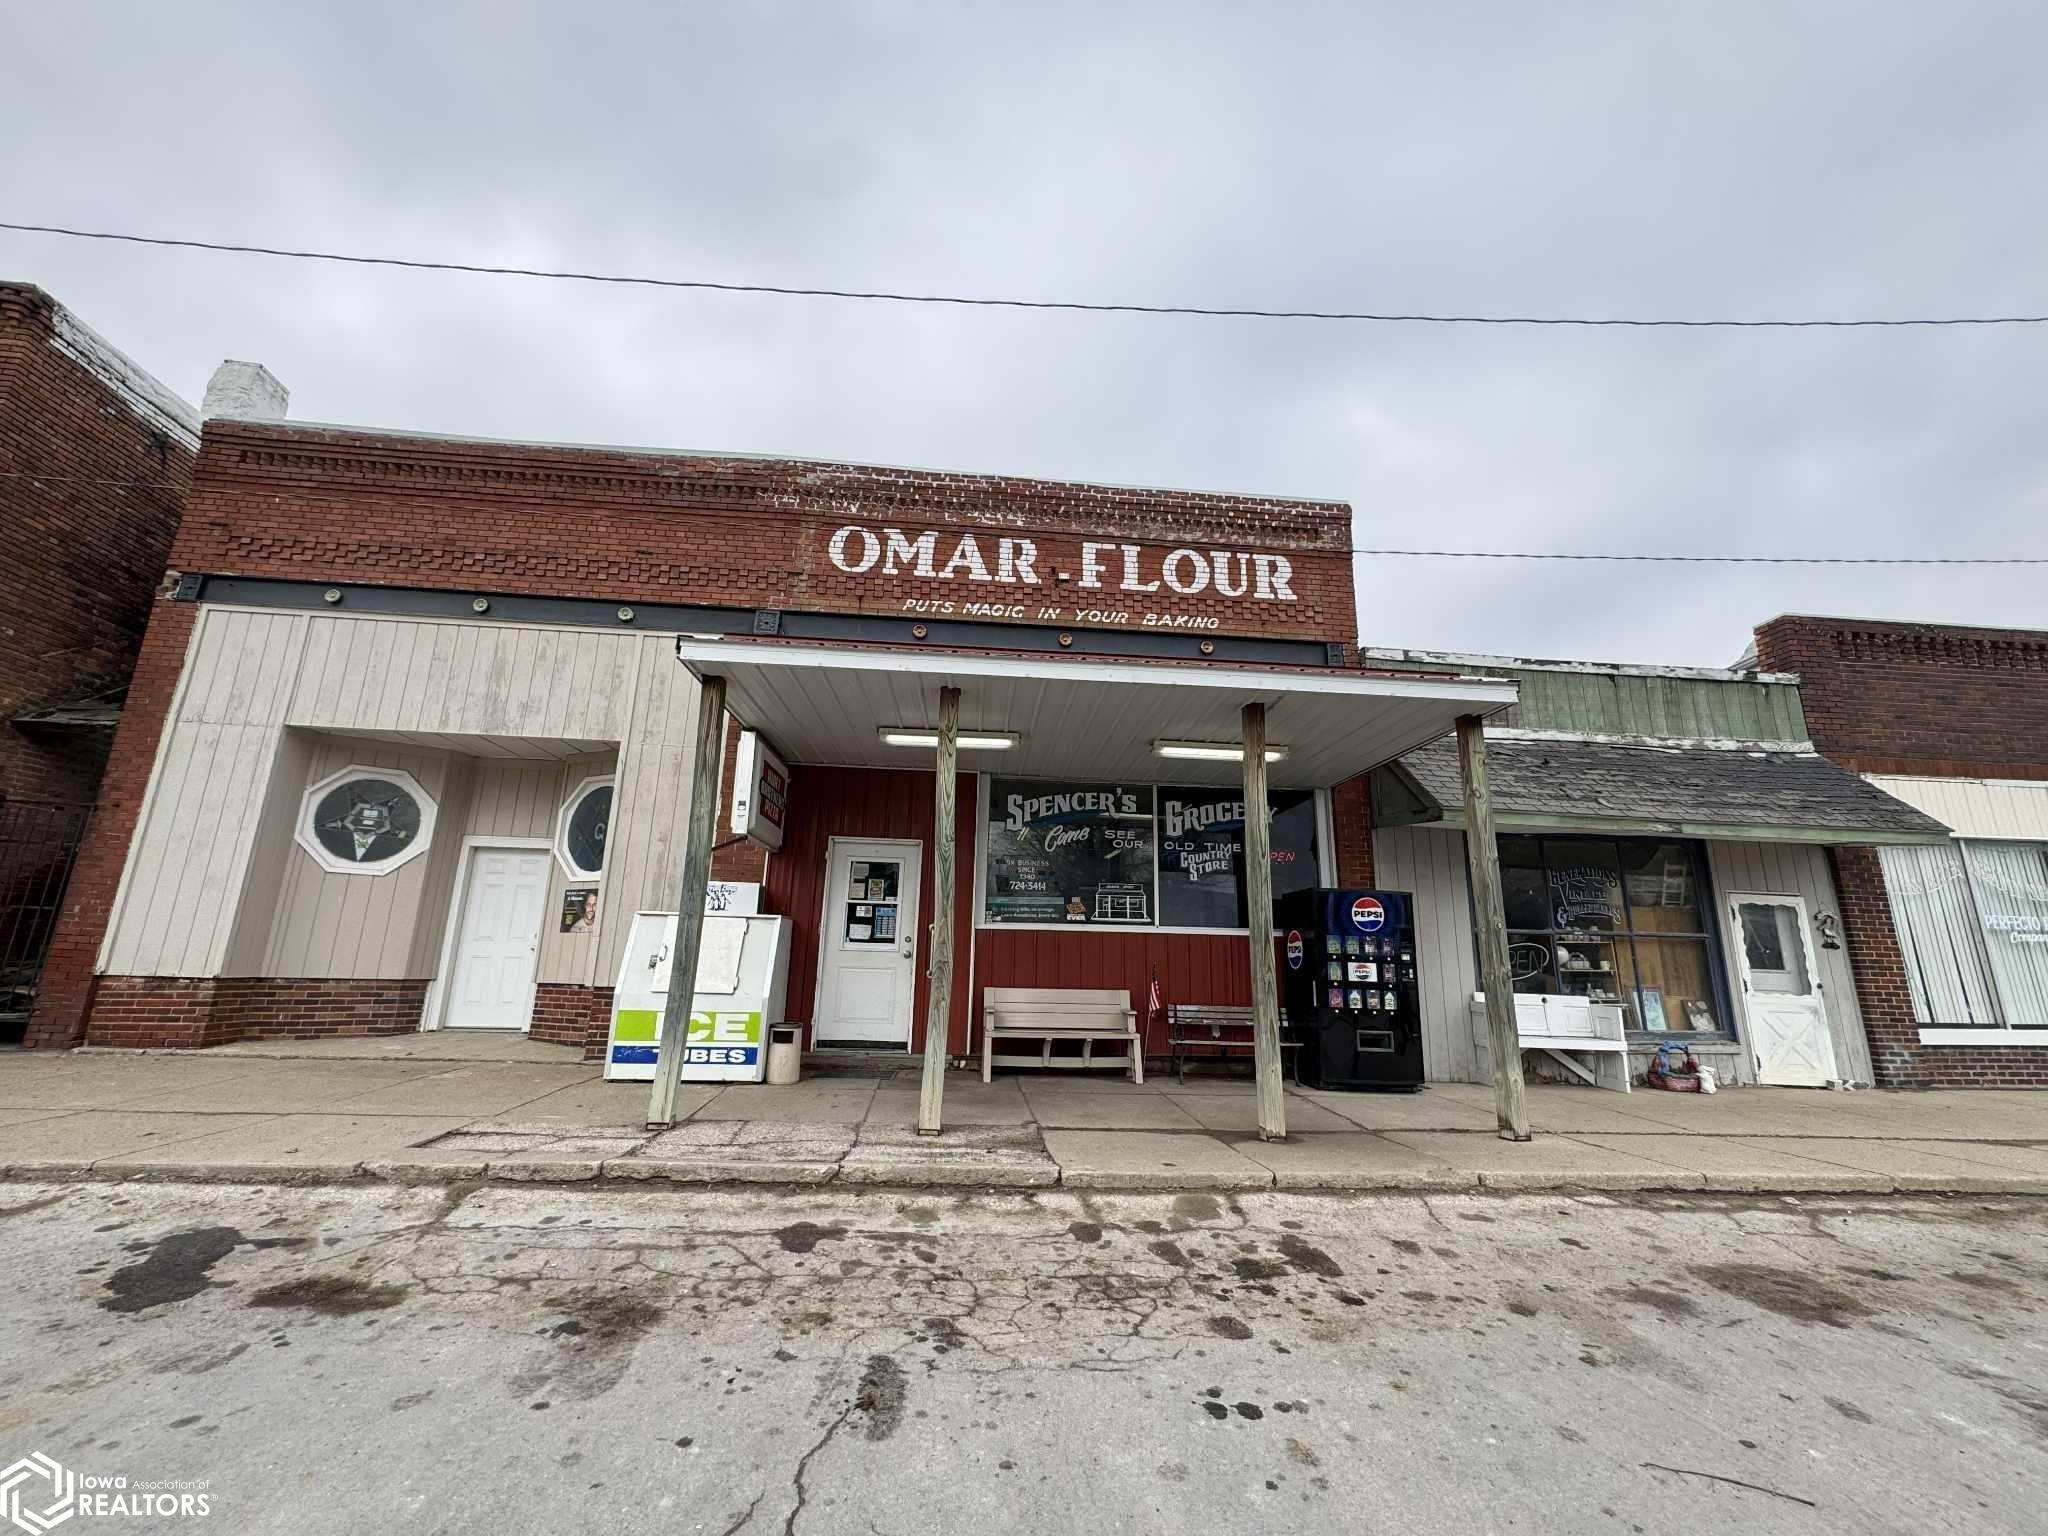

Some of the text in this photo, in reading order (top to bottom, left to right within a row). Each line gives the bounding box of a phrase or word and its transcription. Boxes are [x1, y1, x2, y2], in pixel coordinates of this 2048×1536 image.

[828, 525, 1299, 601] OMAR FLOUR
[902, 598, 1219, 629] PUTS MAGIC IN YOUR BAKING
[1006, 787, 1277, 837] SPENCER'S GROCEY
[1044, 825, 1136, 852] Come SEE
[1112, 839, 1241, 853] OUR OLD TIME
[1179, 850, 1232, 868] COUNTRY
[1270, 851, 1296, 862] PEN
[1189, 859, 1229, 881] STORE
[1353, 909, 1383, 919] PEPSI
[1985, 914, 2041, 931] PERFECTO
[1510, 951, 1544, 972] PEN
